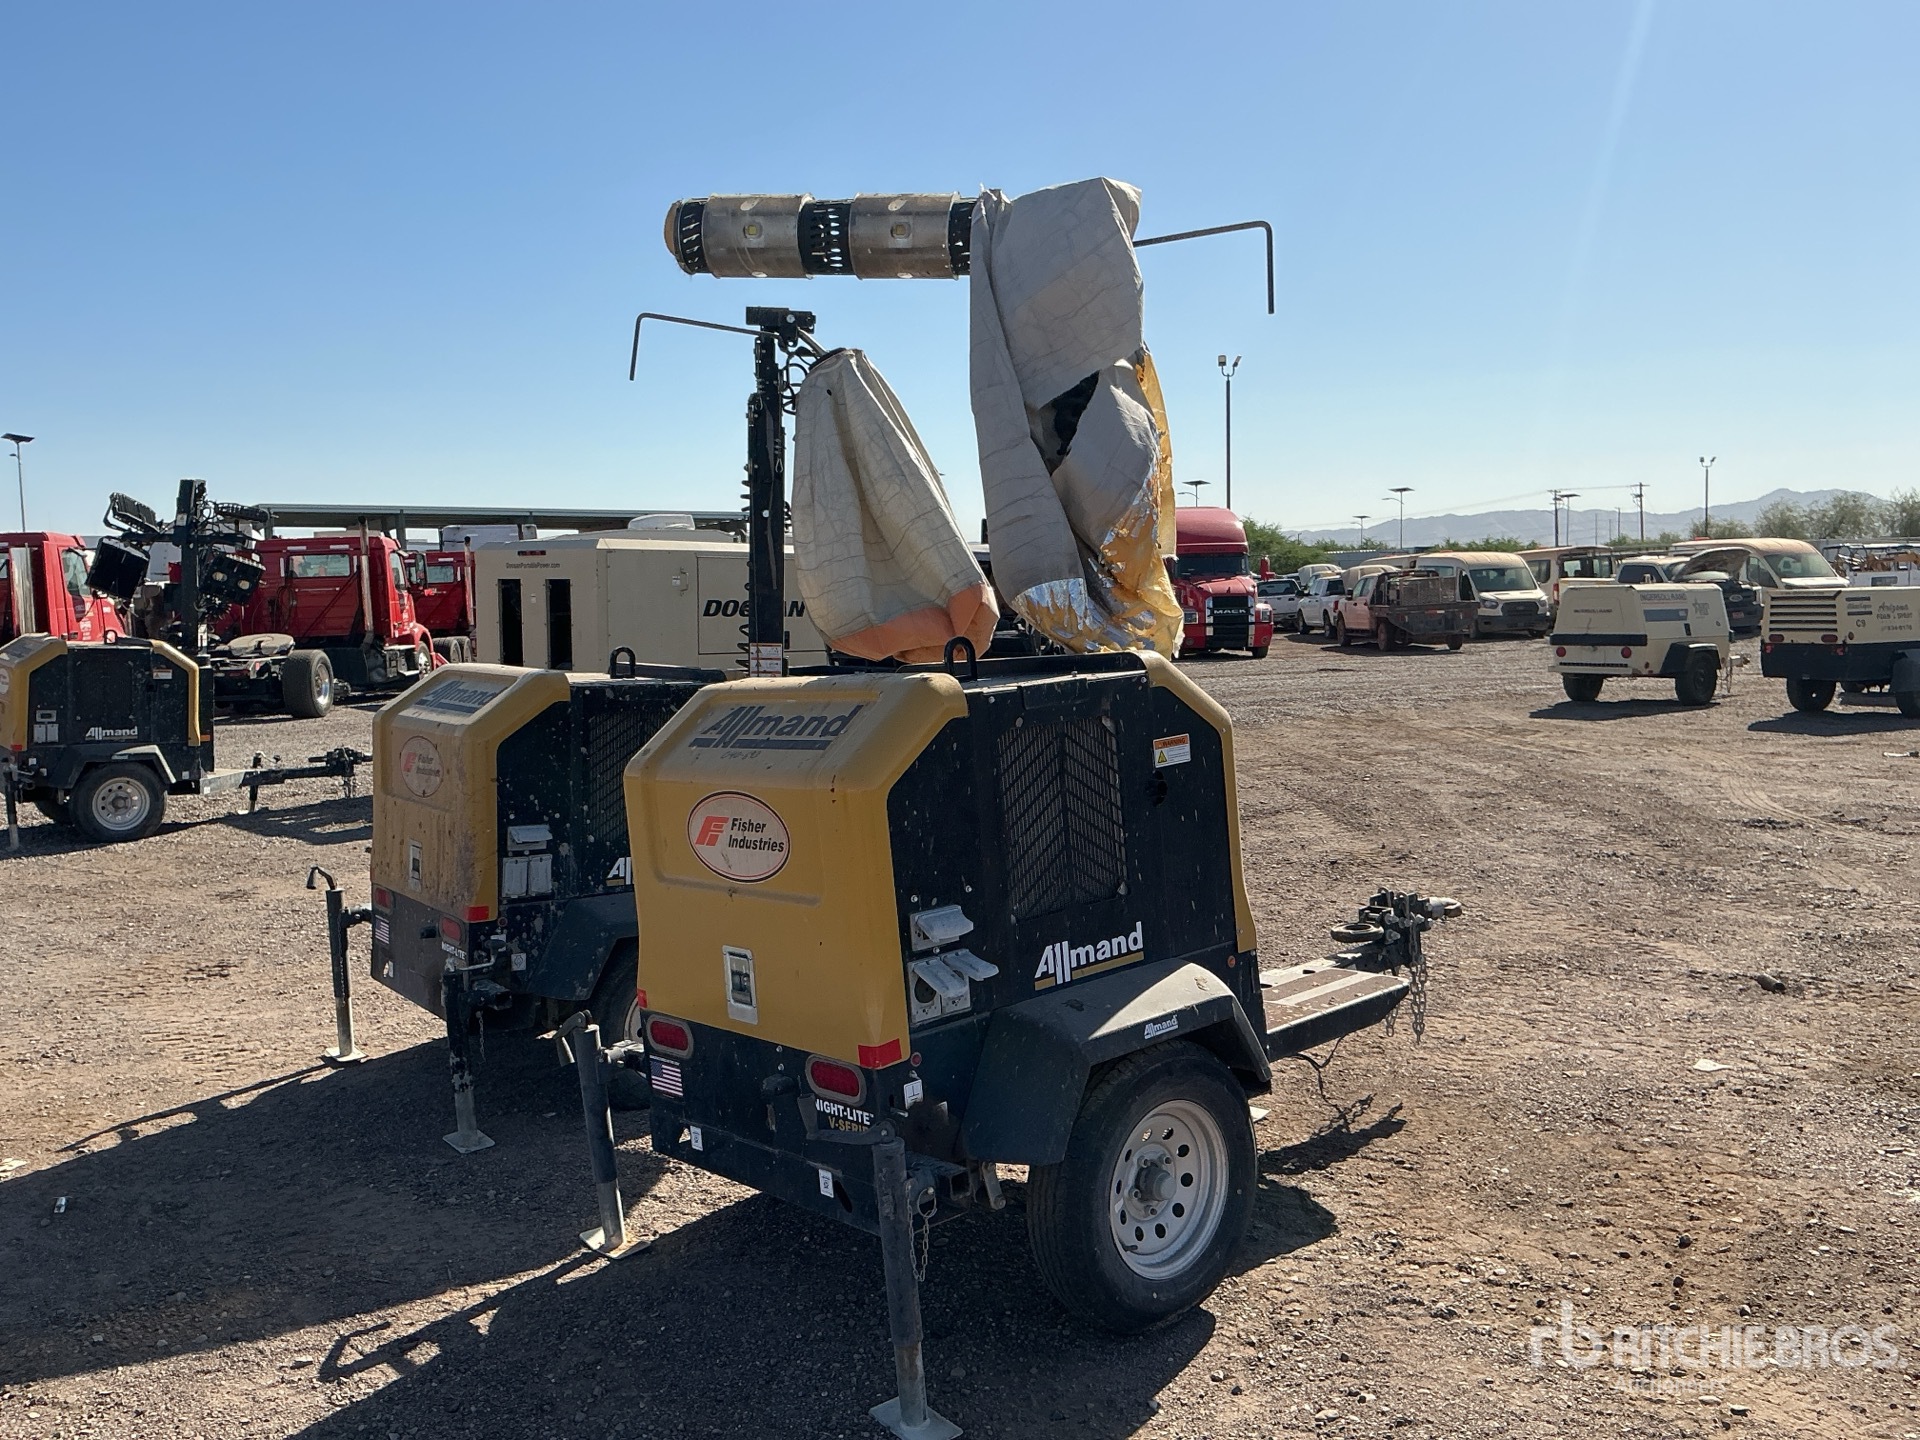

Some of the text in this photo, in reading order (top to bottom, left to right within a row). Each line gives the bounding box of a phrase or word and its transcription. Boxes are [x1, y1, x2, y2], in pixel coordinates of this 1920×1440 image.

[702, 599, 806, 617] DON
[86, 725, 138, 740] Allmand
[700, 704, 865, 748] Allmand
[730, 817, 767, 833] Fisher
[728, 834, 785, 853] Industries
[1034, 921, 1144, 985] Allmand
[1144, 1015, 1178, 1038] Allmand
